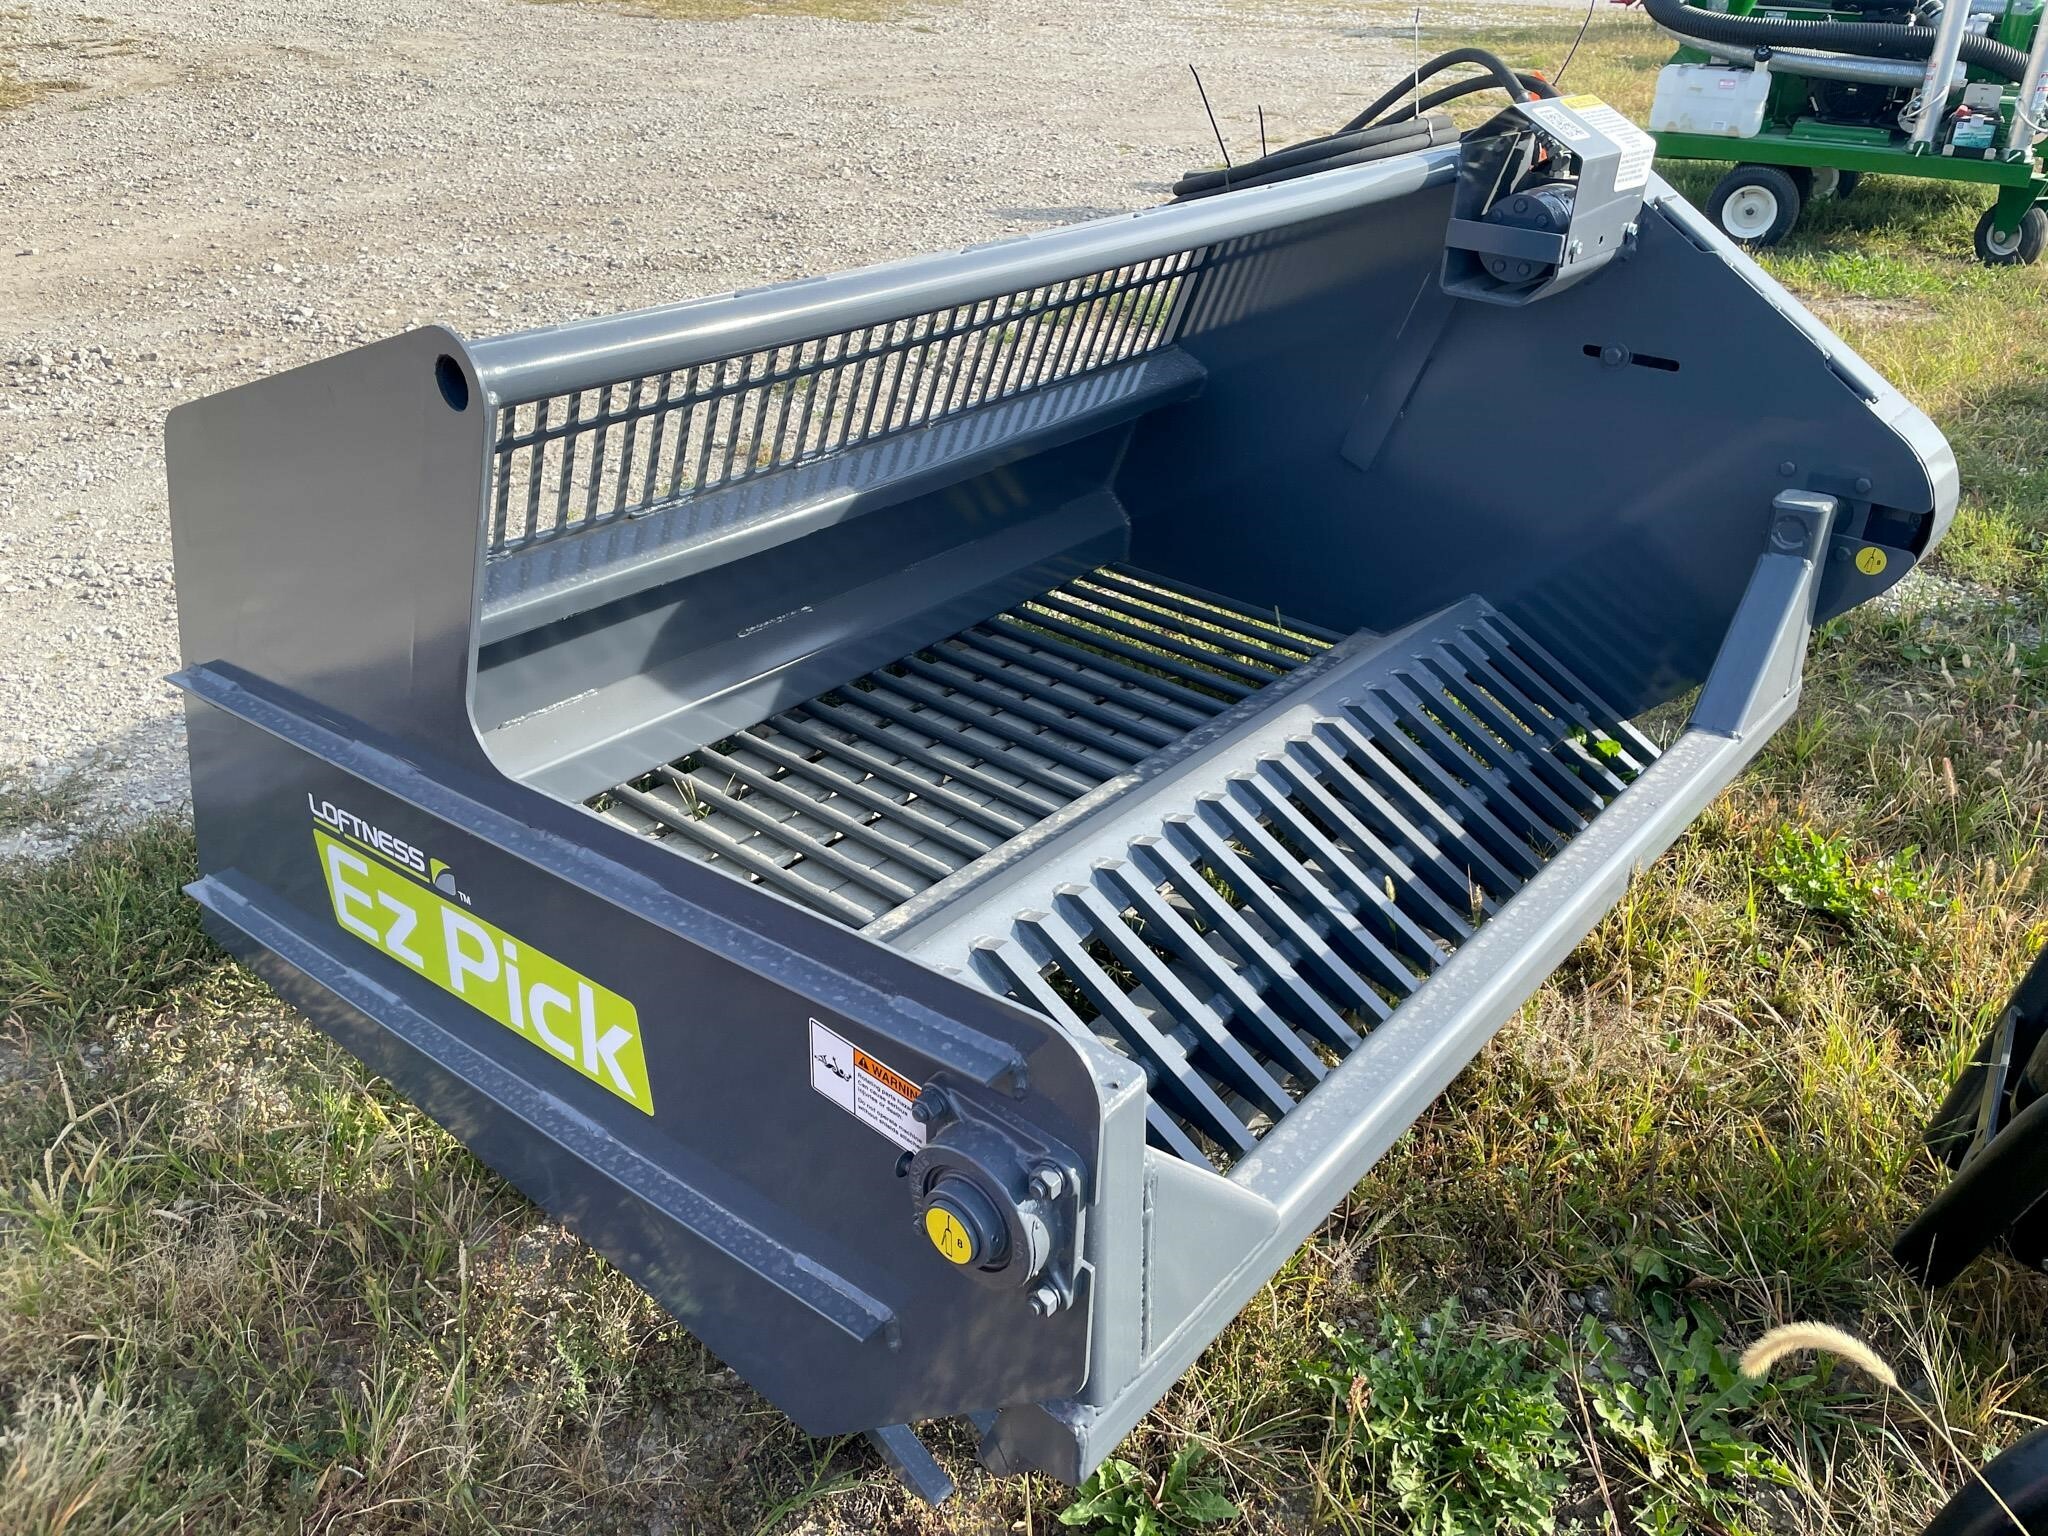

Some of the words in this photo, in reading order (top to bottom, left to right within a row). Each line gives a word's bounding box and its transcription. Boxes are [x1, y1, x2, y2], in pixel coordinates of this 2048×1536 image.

[308, 793, 425, 872] LOFTNESS
[457, 891, 471, 905] TM
[327, 844, 425, 969] Ez
[441, 905, 636, 1099] Pick
[872, 1064, 918, 1099] WARNIN
[900, 1133, 922, 1149] attache
